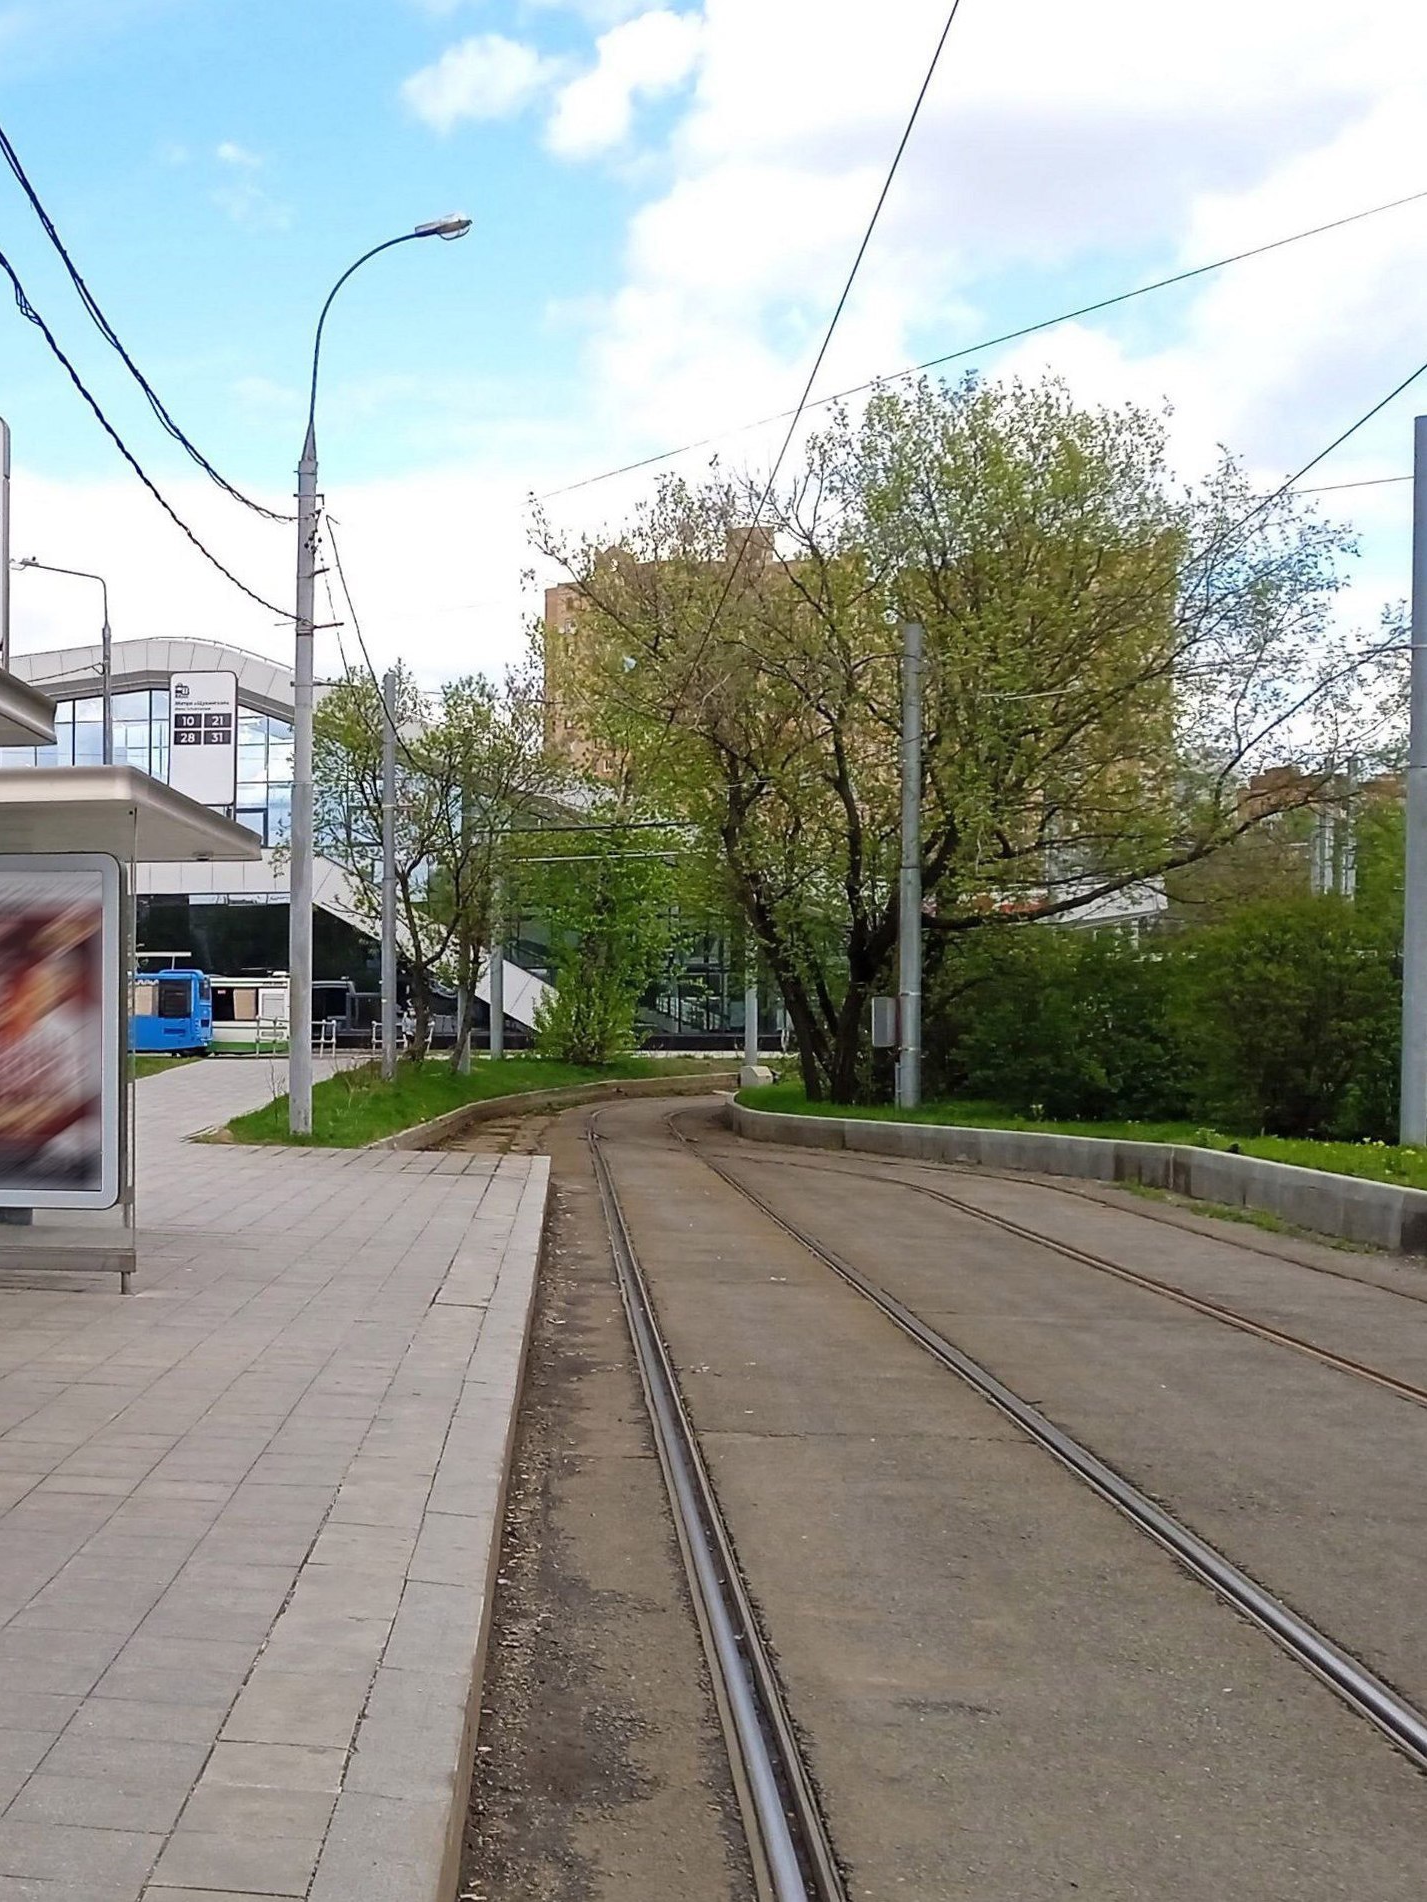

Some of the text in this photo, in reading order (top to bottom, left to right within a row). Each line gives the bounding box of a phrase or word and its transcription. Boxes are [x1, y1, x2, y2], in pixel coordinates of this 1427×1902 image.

[182, 715, 223, 726] 10 21
[180, 732, 223, 743] 28 31
